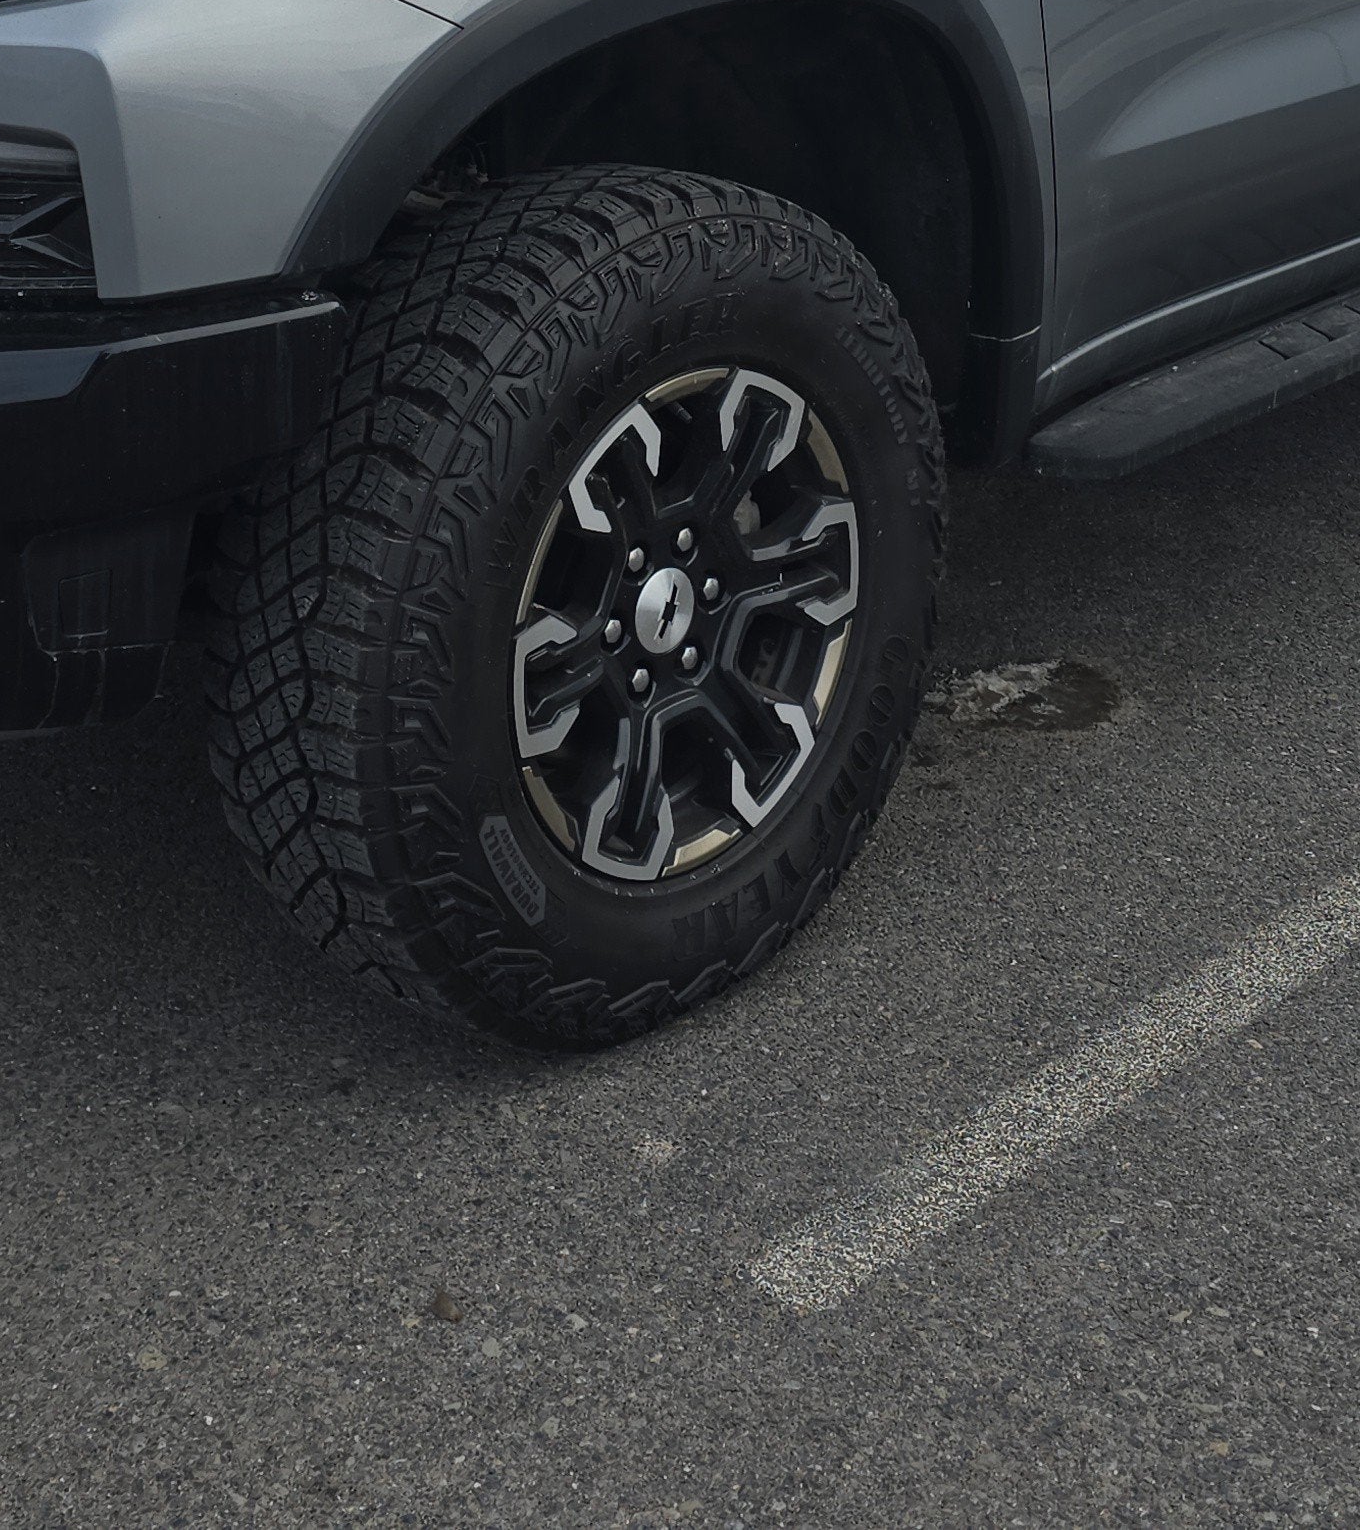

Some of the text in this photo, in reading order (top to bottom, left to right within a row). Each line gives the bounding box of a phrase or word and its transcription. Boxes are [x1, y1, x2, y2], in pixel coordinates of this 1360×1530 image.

[486, 289, 746, 587] WRANGLER
[482, 823, 540, 919] DURAWALL
[673, 635, 908, 962] GOODYEAR
